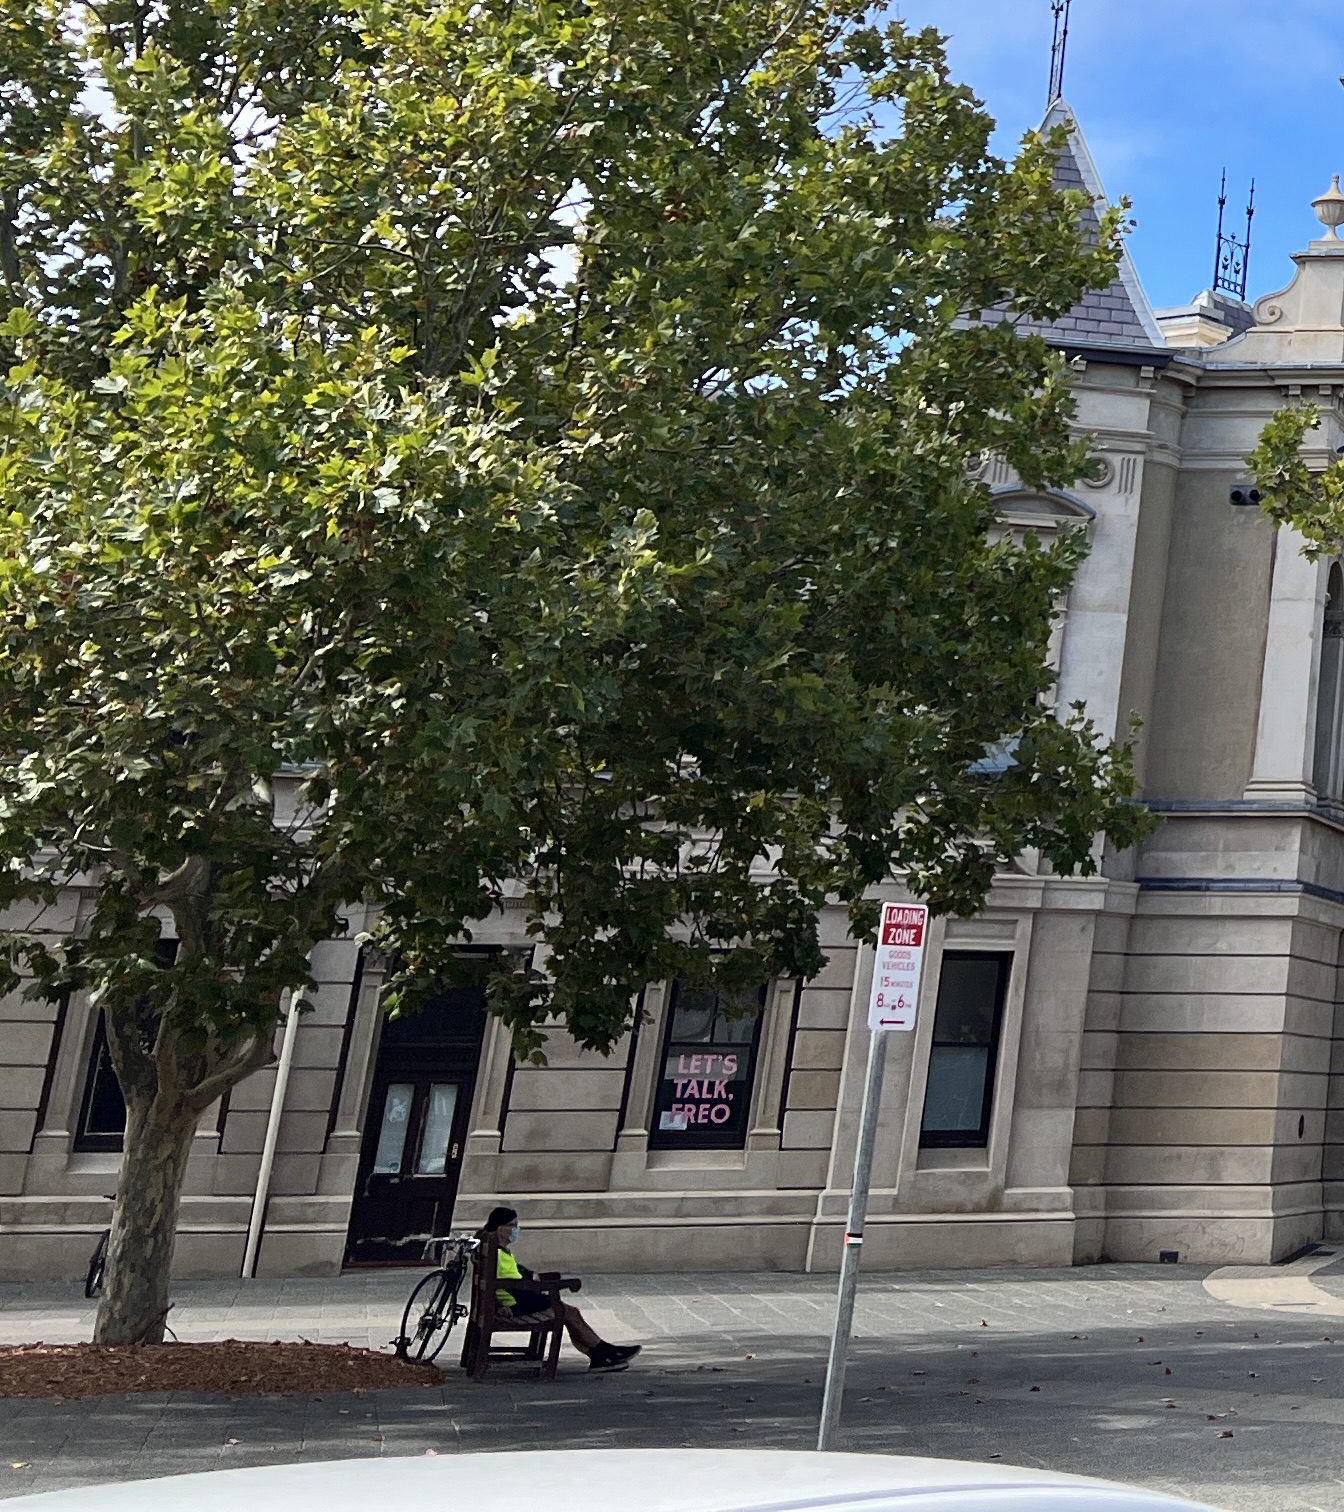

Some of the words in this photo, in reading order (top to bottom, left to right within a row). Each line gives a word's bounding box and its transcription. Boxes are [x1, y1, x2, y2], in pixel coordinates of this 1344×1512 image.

[886, 908, 924, 926] LOADING
[887, 928, 917, 945] ZONE
[882, 962, 915, 971] VEHICLES
[678, 1054, 738, 1075] LET'S
[673, 1078, 734, 1101] TALK,
[669, 1103, 731, 1124] FREO
